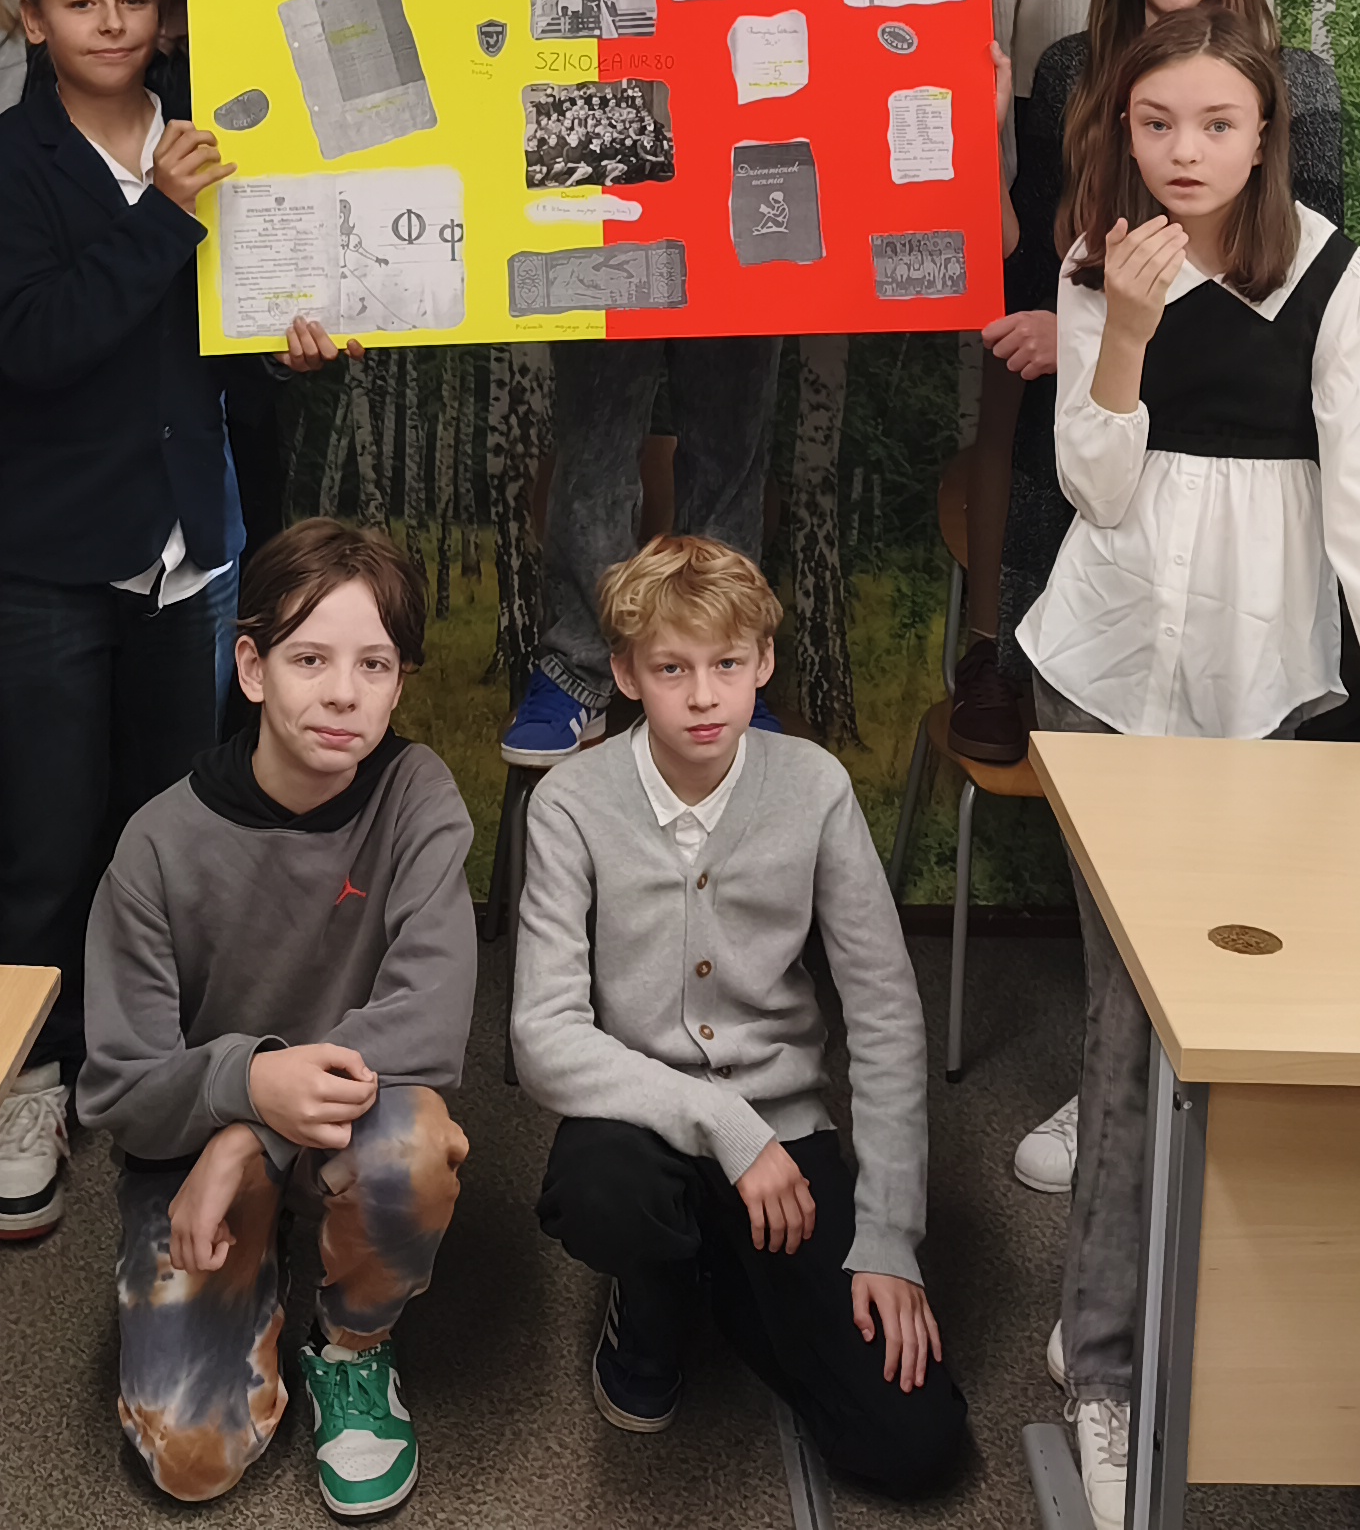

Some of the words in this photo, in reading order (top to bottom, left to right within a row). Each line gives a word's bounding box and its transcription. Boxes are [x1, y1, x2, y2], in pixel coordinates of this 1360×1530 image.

[535, 52, 623, 71] SZKOŁA
[630, 55, 652, 68] NR
[655, 55, 674, 69] 80
[735, 161, 799, 176] Dzienniczek
[752, 175, 784, 186] ucznia
